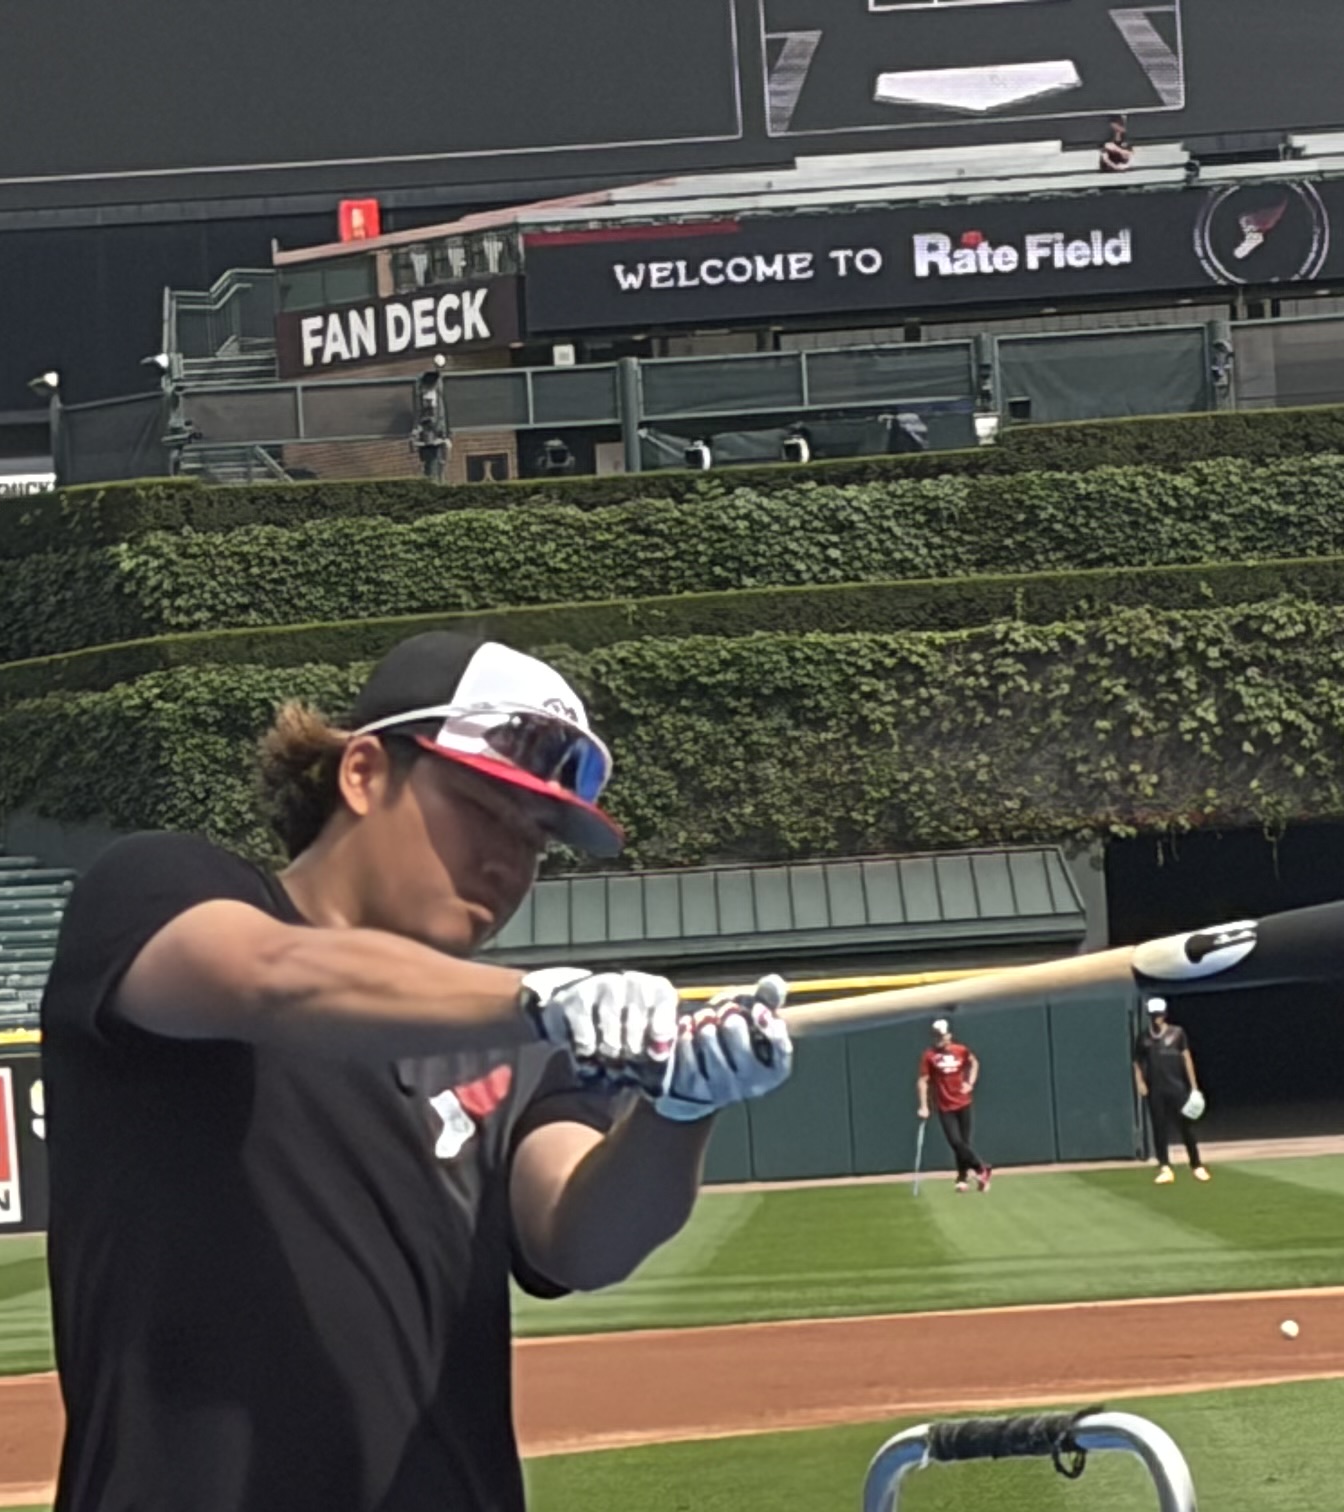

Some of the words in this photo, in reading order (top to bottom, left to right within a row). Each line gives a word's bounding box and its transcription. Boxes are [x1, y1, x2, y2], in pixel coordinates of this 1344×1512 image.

[613, 253, 813, 290] WELCOME
[829, 248, 883, 277] TO
[913, 233, 1019, 277] Rate
[1026, 229, 1131, 270] Field
[301, 304, 376, 367] FAN
[386, 289, 490, 353] DECK
